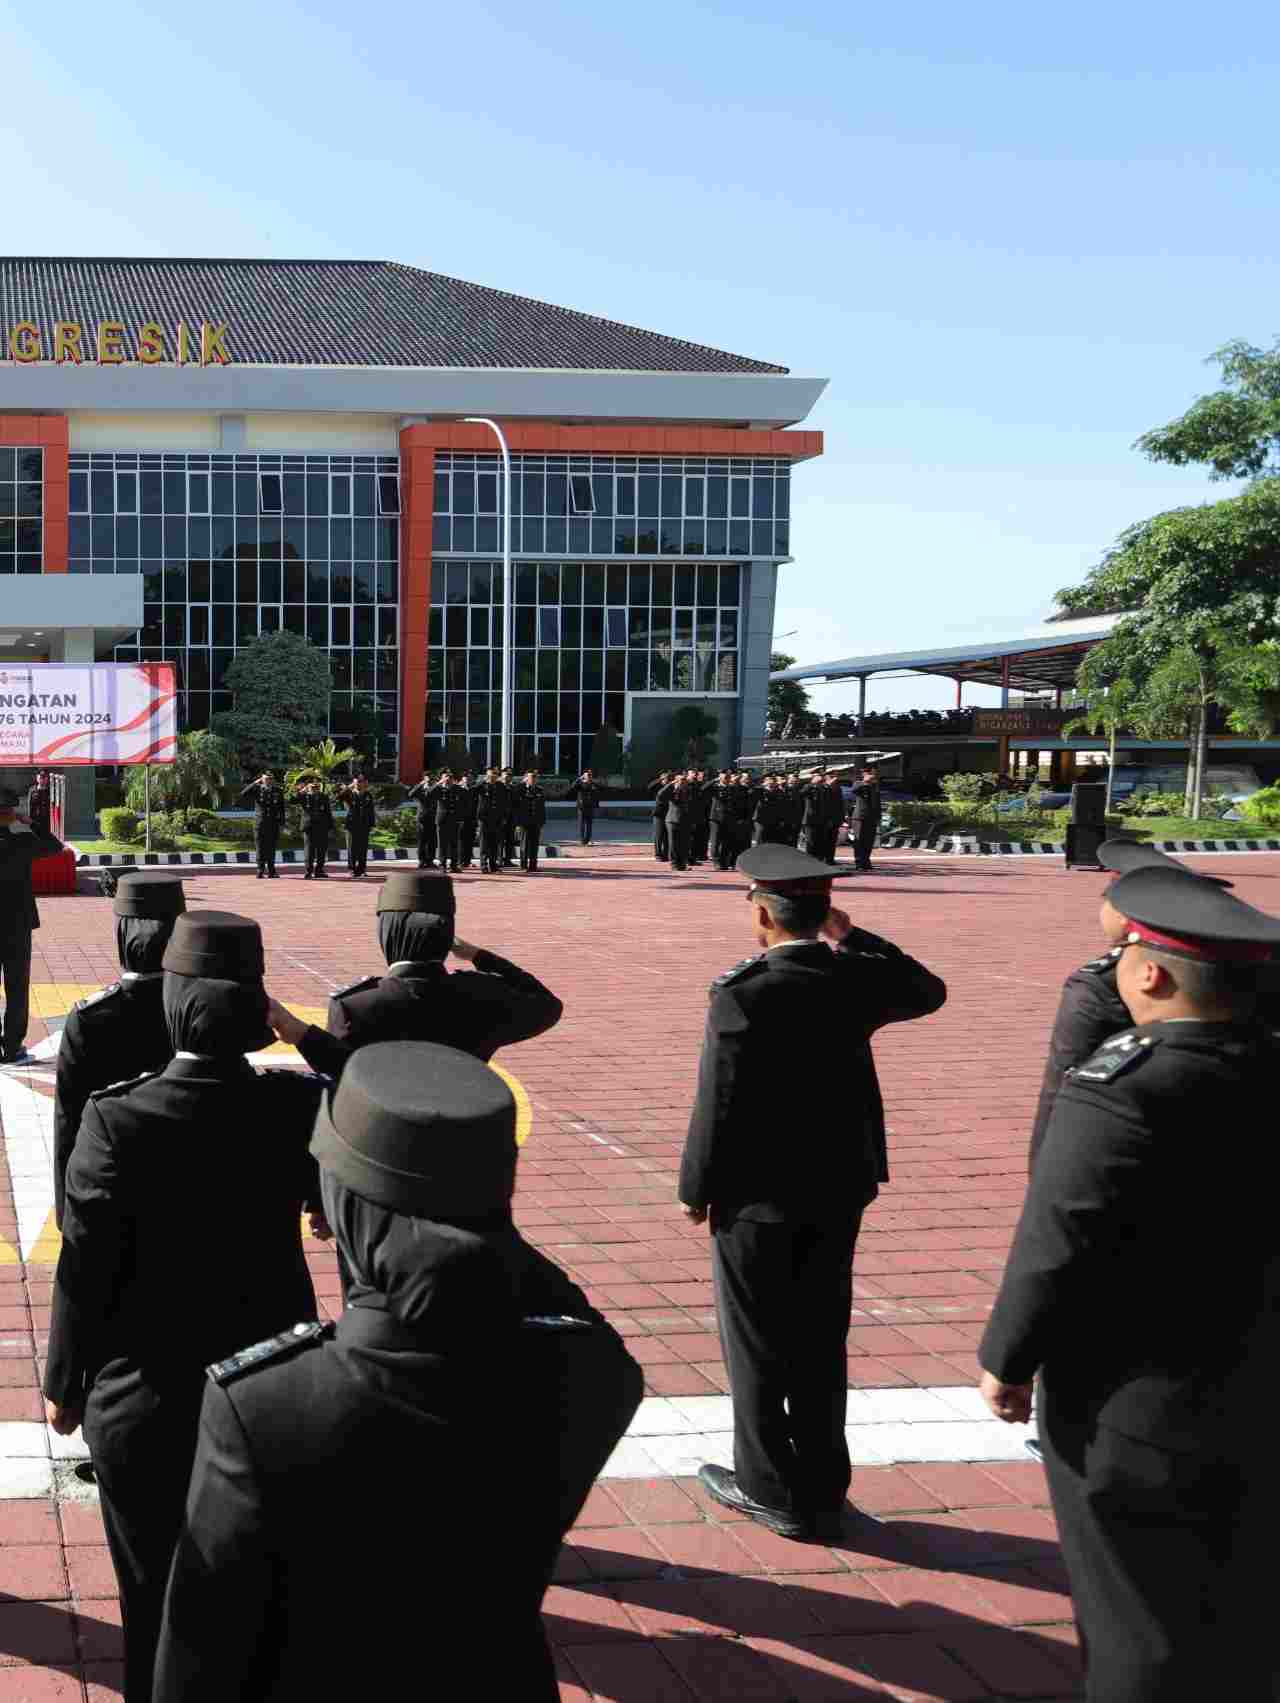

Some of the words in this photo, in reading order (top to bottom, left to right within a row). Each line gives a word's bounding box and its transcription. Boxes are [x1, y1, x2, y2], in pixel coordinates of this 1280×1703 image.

[9, 319, 232, 366] GRESIK
[19, 713, 71, 725] TAHUN
[74, 713, 112, 724] 2024
